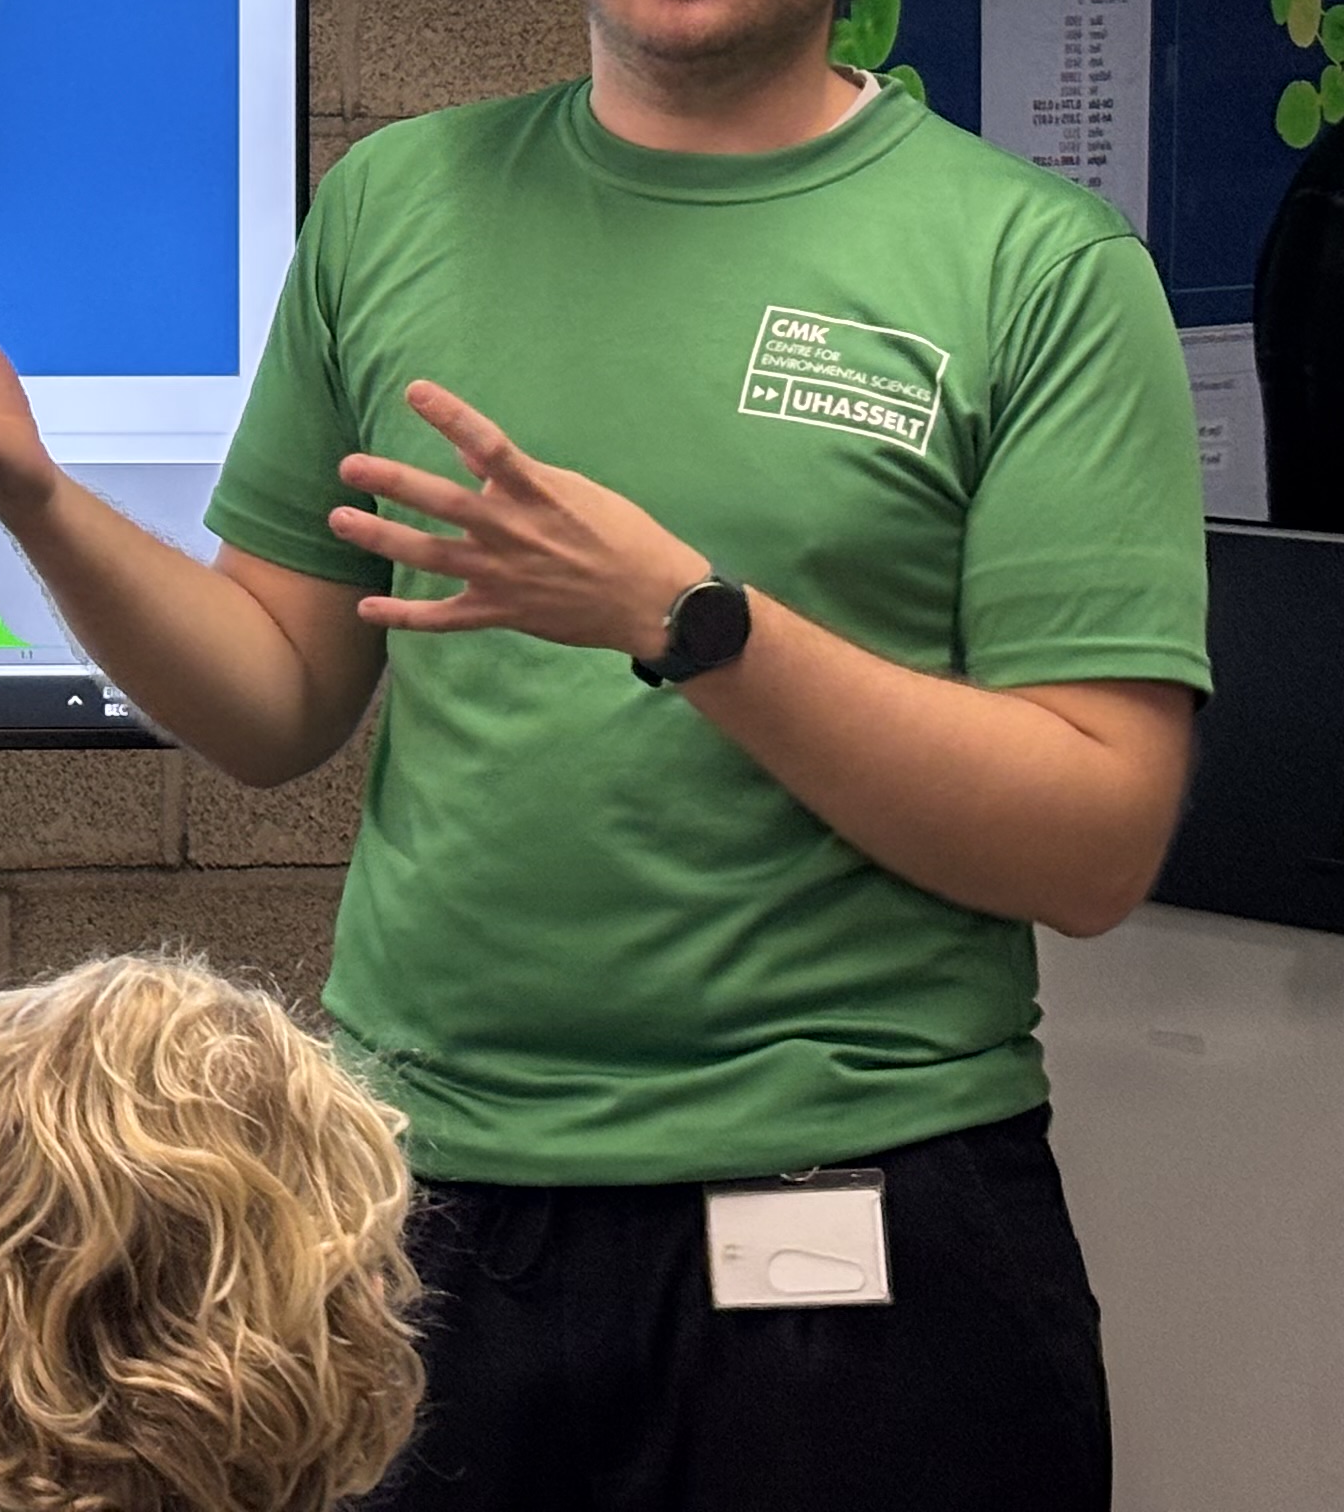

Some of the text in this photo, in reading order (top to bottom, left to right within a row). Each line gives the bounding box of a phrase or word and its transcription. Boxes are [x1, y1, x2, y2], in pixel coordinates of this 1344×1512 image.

[772, 320, 829, 344] CMK
[765, 339, 841, 362] CENTRE FOR
[761, 354, 932, 403] ENVIRONMENTAL SCIENCES
[791, 390, 924, 440] UHASSELT
